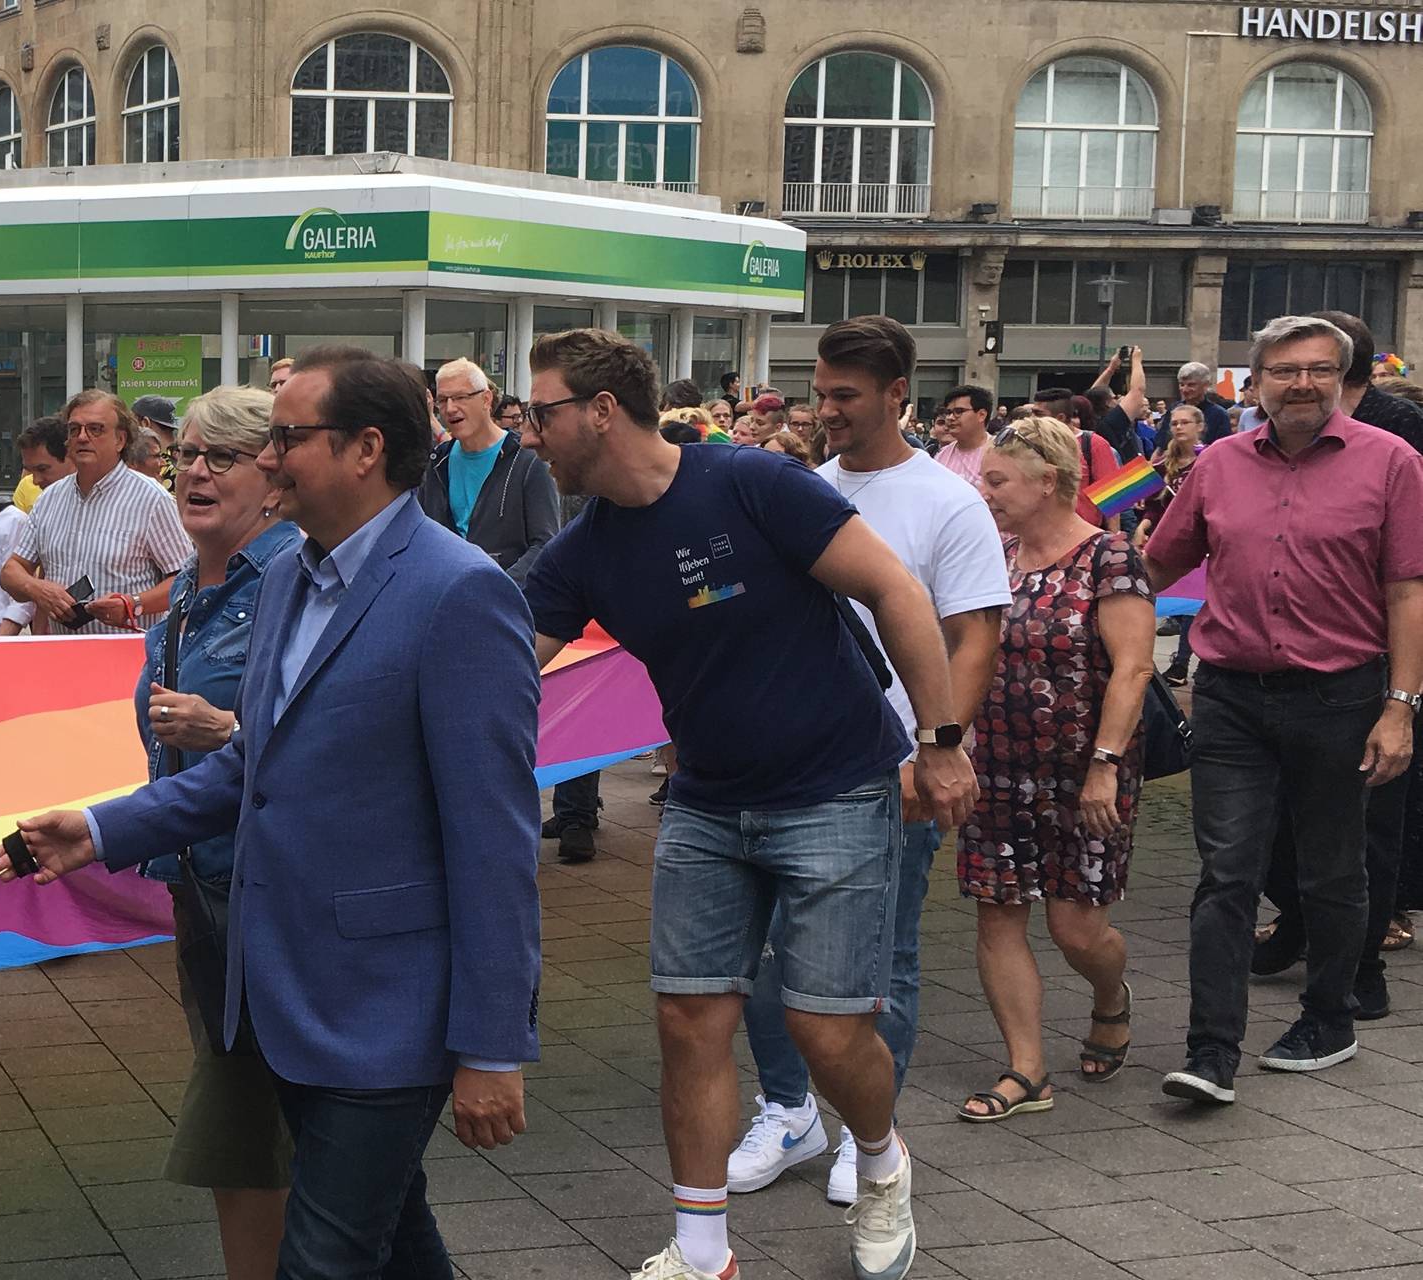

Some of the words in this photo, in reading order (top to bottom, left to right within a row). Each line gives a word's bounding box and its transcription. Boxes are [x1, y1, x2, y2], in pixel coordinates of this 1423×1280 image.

[1241, 7, 1423, 43] HANDELSH
[303, 226, 377, 250] GALERIA
[749, 256, 780, 278] GALERIA
[837, 253, 906, 269] ROLEX
[120, 379, 145, 388] asien
[146, 378, 199, 389] supermarkt
[675, 546, 691, 560] Wir
[681, 570, 706, 586] bunt!
